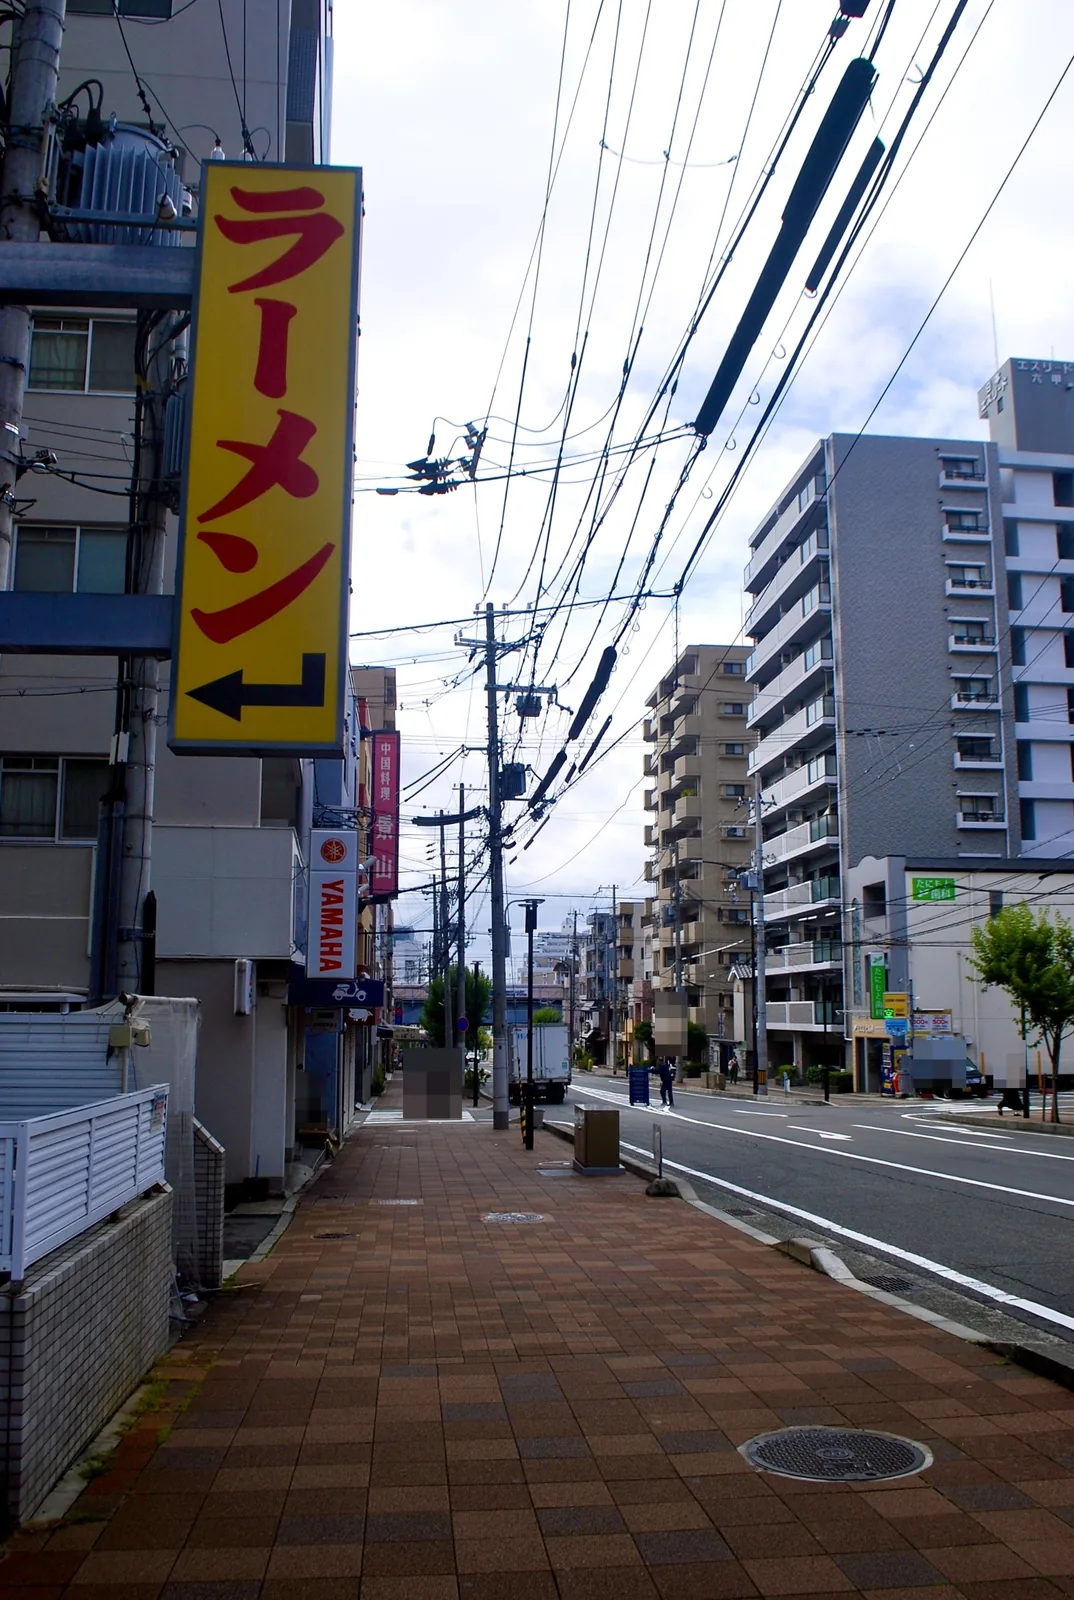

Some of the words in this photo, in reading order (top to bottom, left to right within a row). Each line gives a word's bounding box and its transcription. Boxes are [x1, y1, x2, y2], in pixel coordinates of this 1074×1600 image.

[190, 186, 345, 644] ラーメン
[380, 742, 391, 801] 中国料理
[320, 879, 344, 972] YAMAHA
